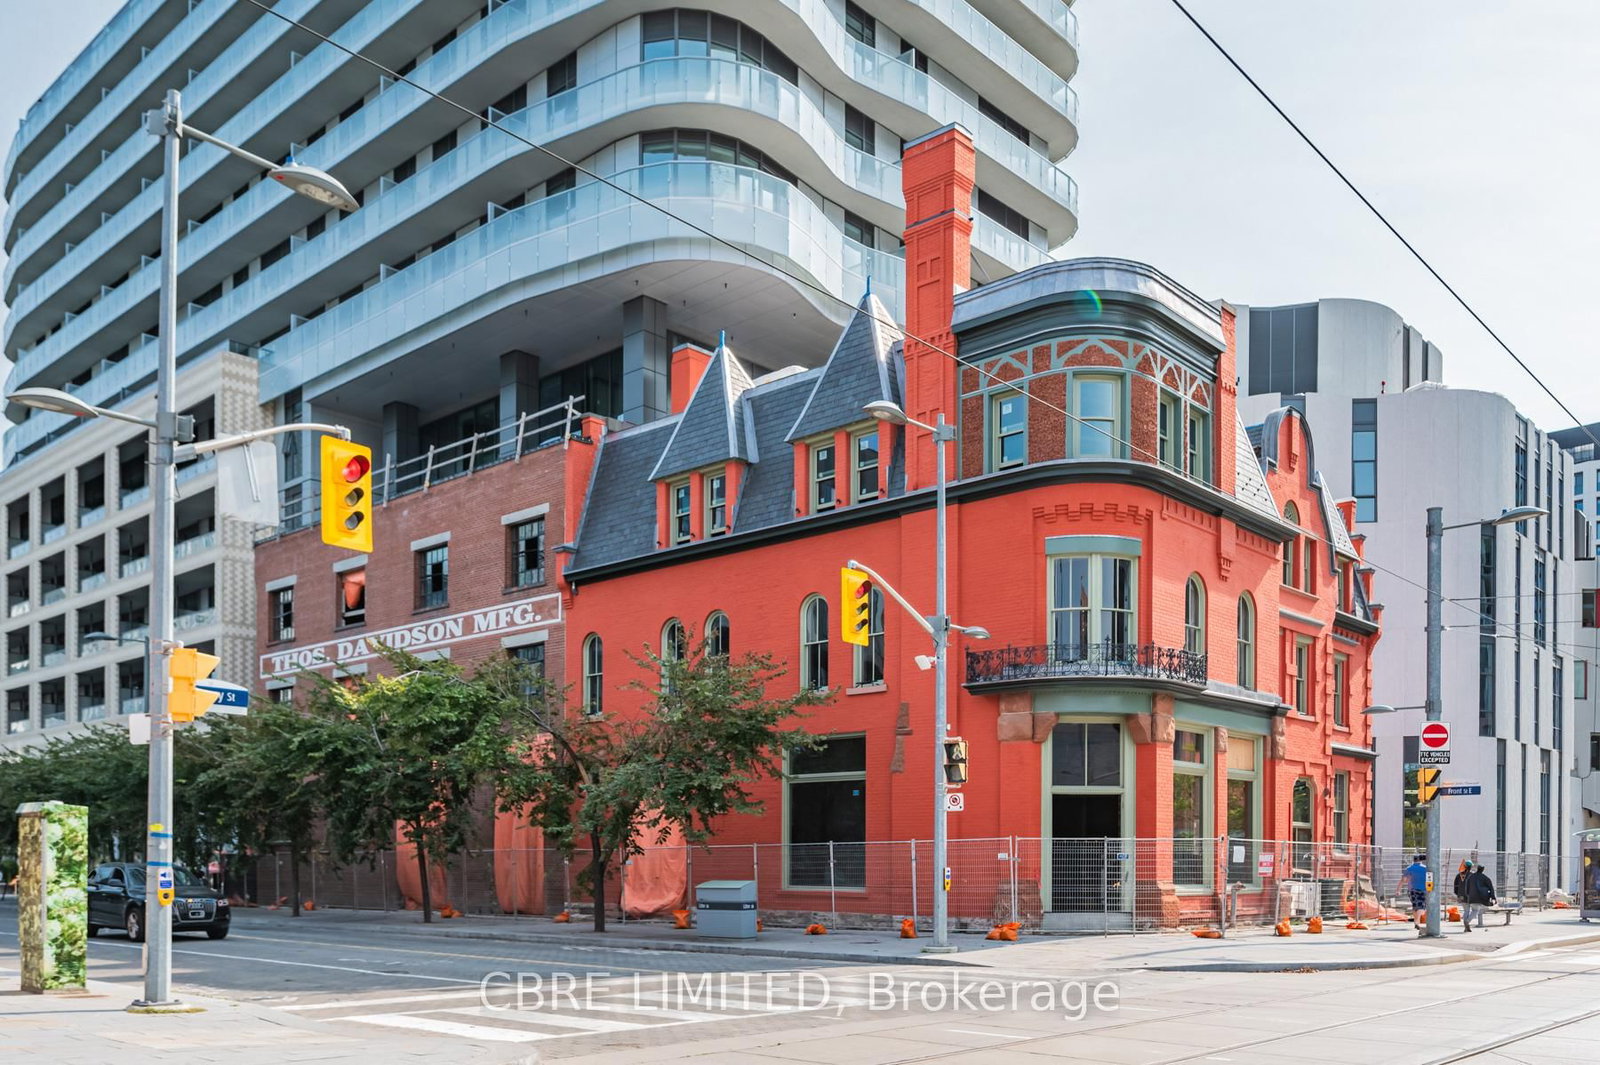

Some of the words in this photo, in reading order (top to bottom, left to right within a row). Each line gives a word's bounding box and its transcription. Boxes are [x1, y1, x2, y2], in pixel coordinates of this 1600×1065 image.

[271, 647, 330, 672] THOS.
[473, 603, 542, 633] MFG.
[226, 692, 236, 702] St
